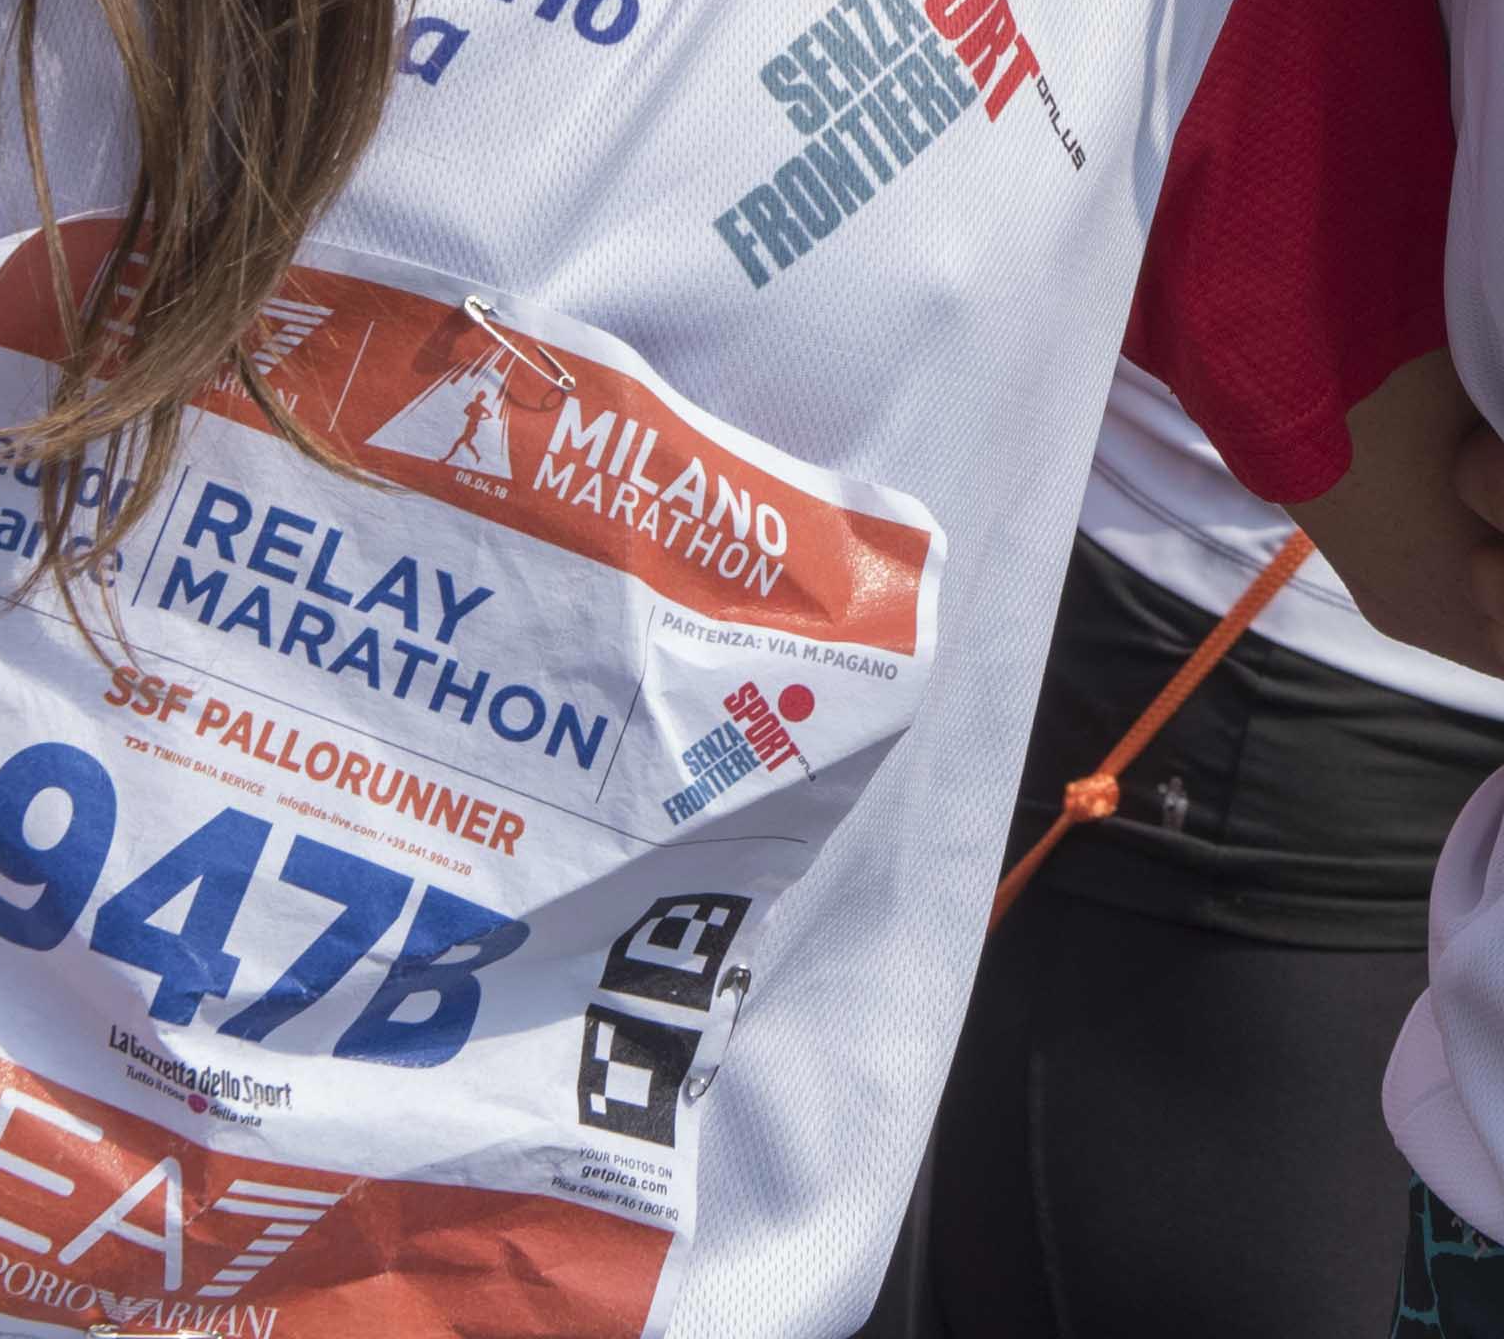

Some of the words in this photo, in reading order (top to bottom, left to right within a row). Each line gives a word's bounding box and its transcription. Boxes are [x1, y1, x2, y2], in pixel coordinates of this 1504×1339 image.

[713, 29, 980, 289] FRONTIERE
[546, 397, 789, 557] MILANO
[182, 481, 495, 645] RELAY
[533, 455, 784, 598] MARATHON
[158, 557, 608, 770] MARATHON
[662, 611, 761, 650] PARTENZA:
[768, 637, 797, 659] VIA
[802, 646, 898, 681] M.PAGANO
[104, 665, 194, 724] SSF
[196, 698, 526, 858] PALLORUNNER
[682, 720, 745, 777] SENZA
[723, 680, 800, 774] SPORT
[153, 745, 191, 769] TIMING
[193, 760, 218, 779] DATA
[220, 771, 265, 797] SERVICE
[662, 742, 761, 825] FRONTIERE
[209, 1103, 237, 1123] della
[240, 1113, 262, 1127] vita
[552, 1176, 577, 1192] Pica
[579, 1147, 610, 1163] YOUR
[614, 1154, 656, 1175] PHOTOS
[658, 1166, 673, 1180] ON
[581, 1164, 668, 1196] getpica.com
[141, 1297, 280, 1339] ARMANI
